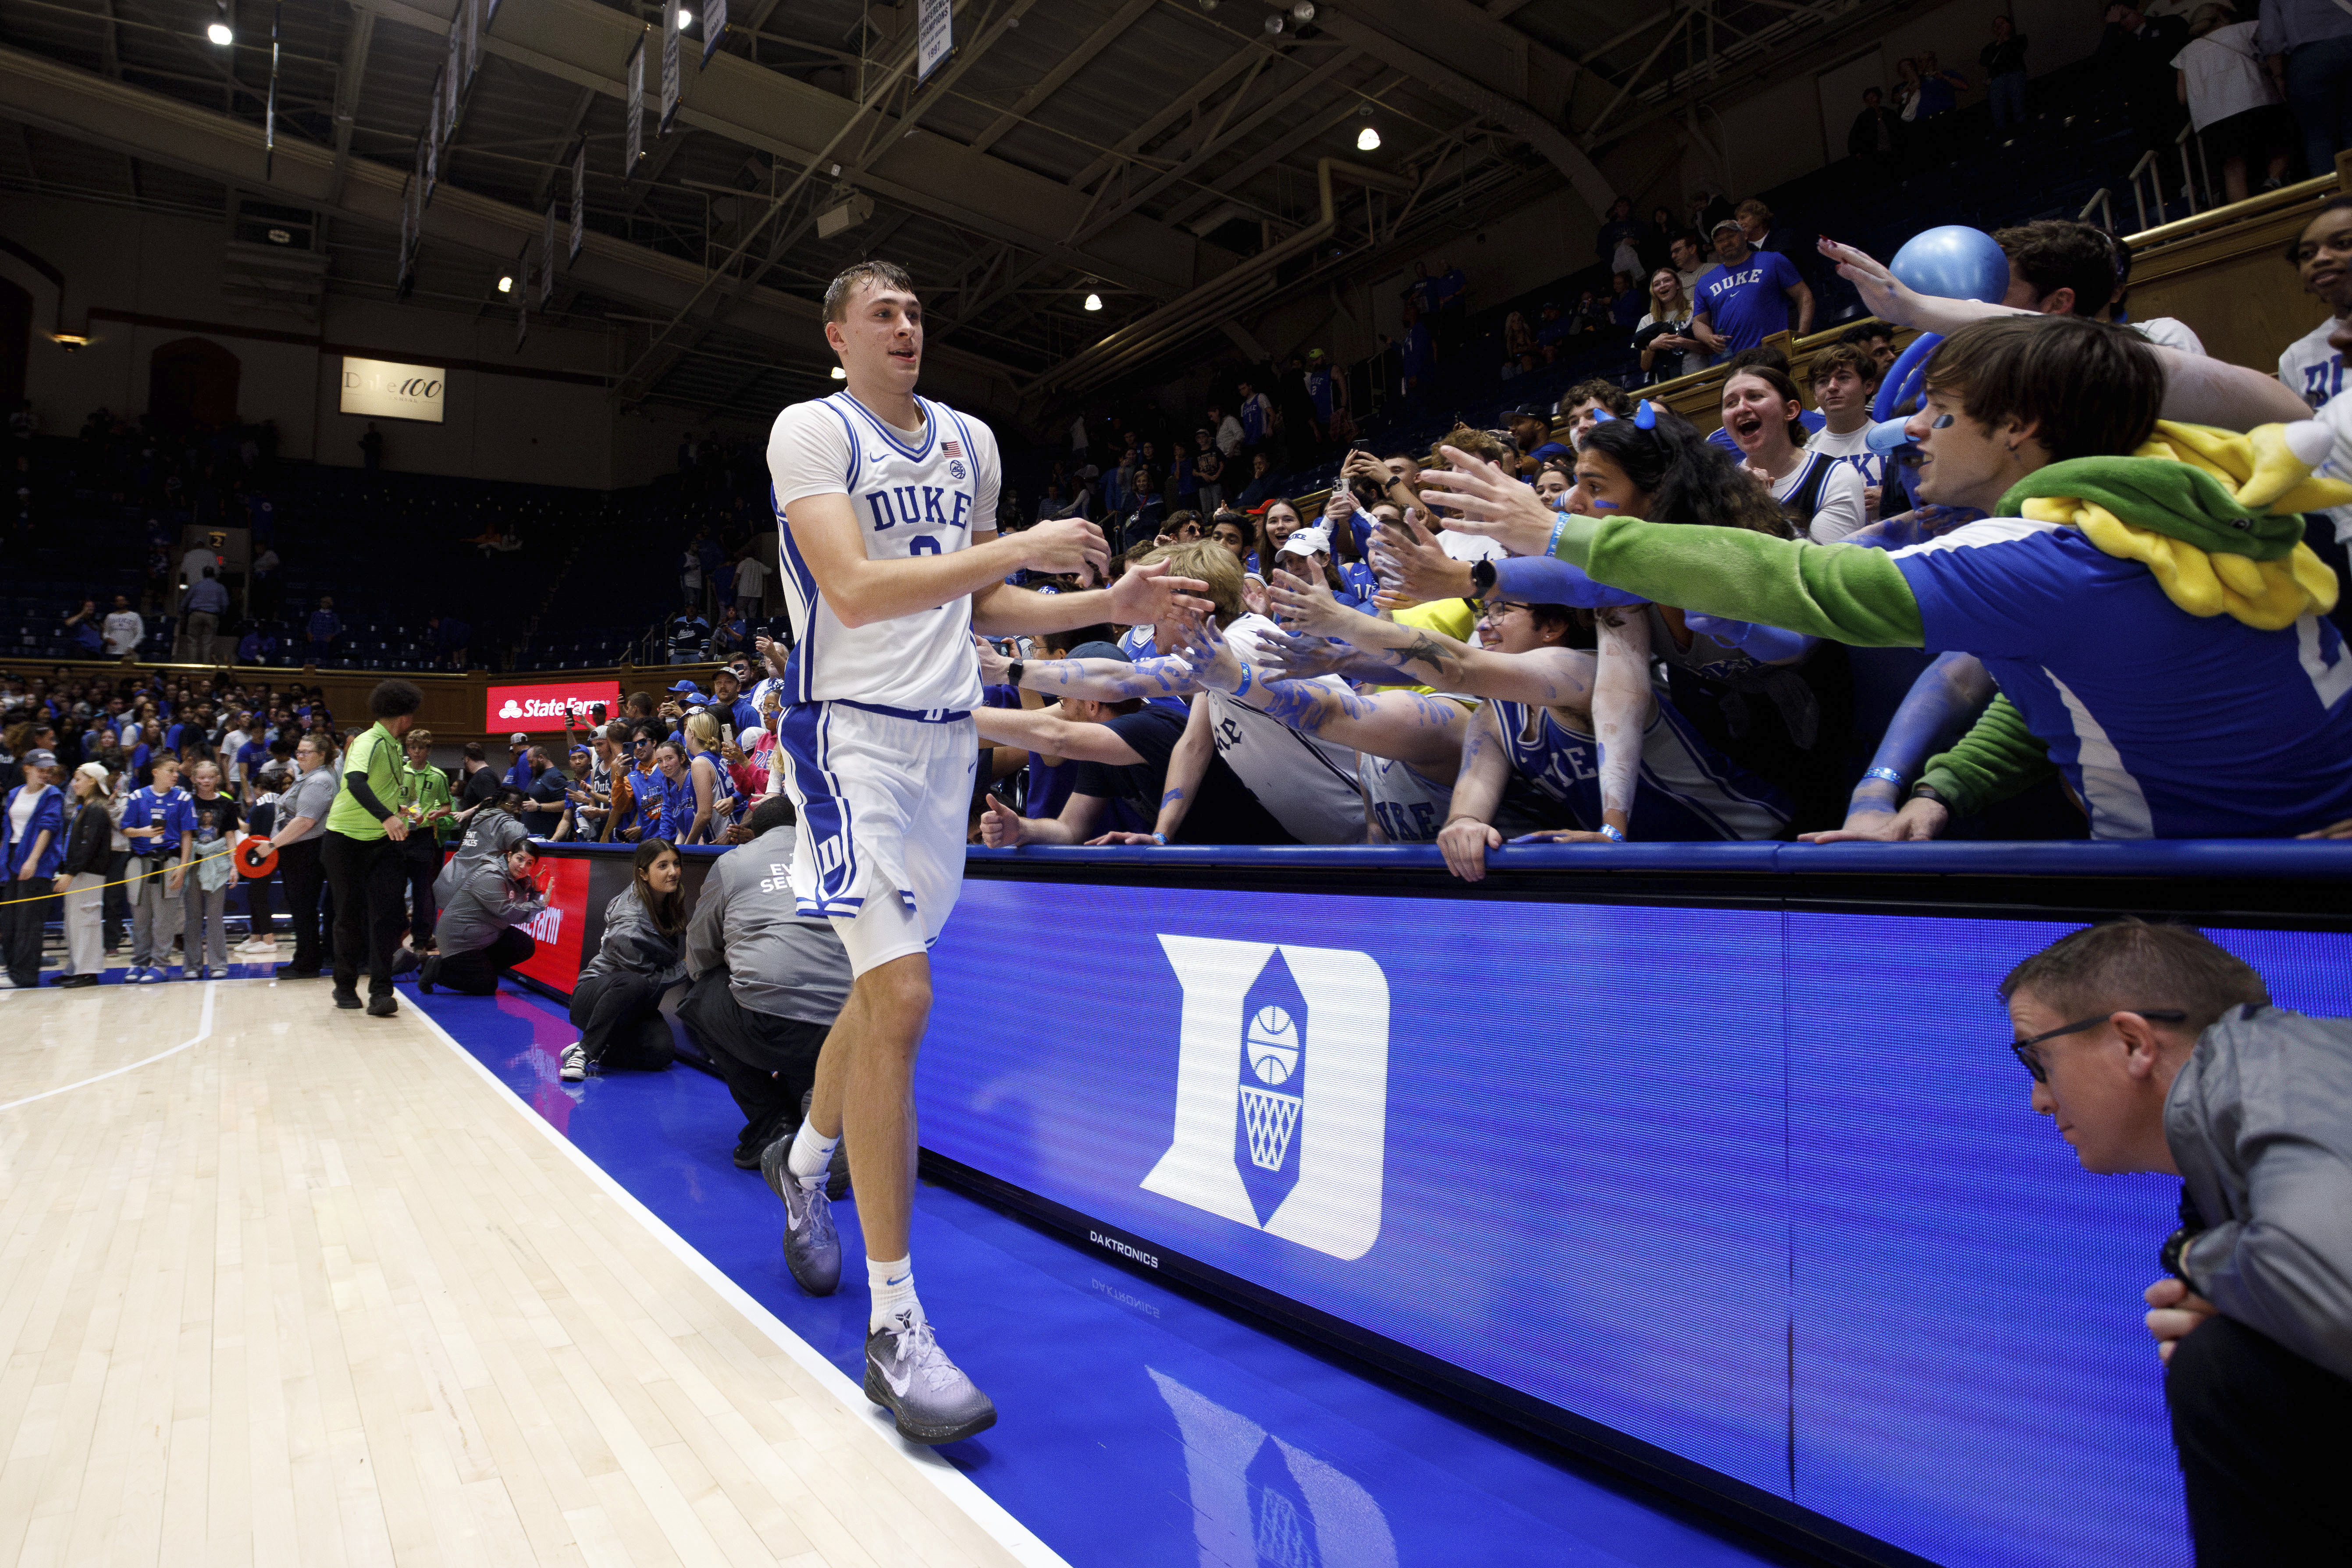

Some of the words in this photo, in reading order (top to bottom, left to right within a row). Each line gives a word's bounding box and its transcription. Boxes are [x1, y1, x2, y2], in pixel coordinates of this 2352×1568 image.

[919, 0, 949, 33] CONFERENC
[928, 40, 940, 60] 1997
[1709, 269, 1763, 297] DUKE
[399, 378, 441, 398] 100
[866, 485, 971, 532] DUKE
[213, 536, 221, 547] 2
[523, 699, 565, 718] State
[1090, 1230, 1158, 1269] DAKTRONICS
